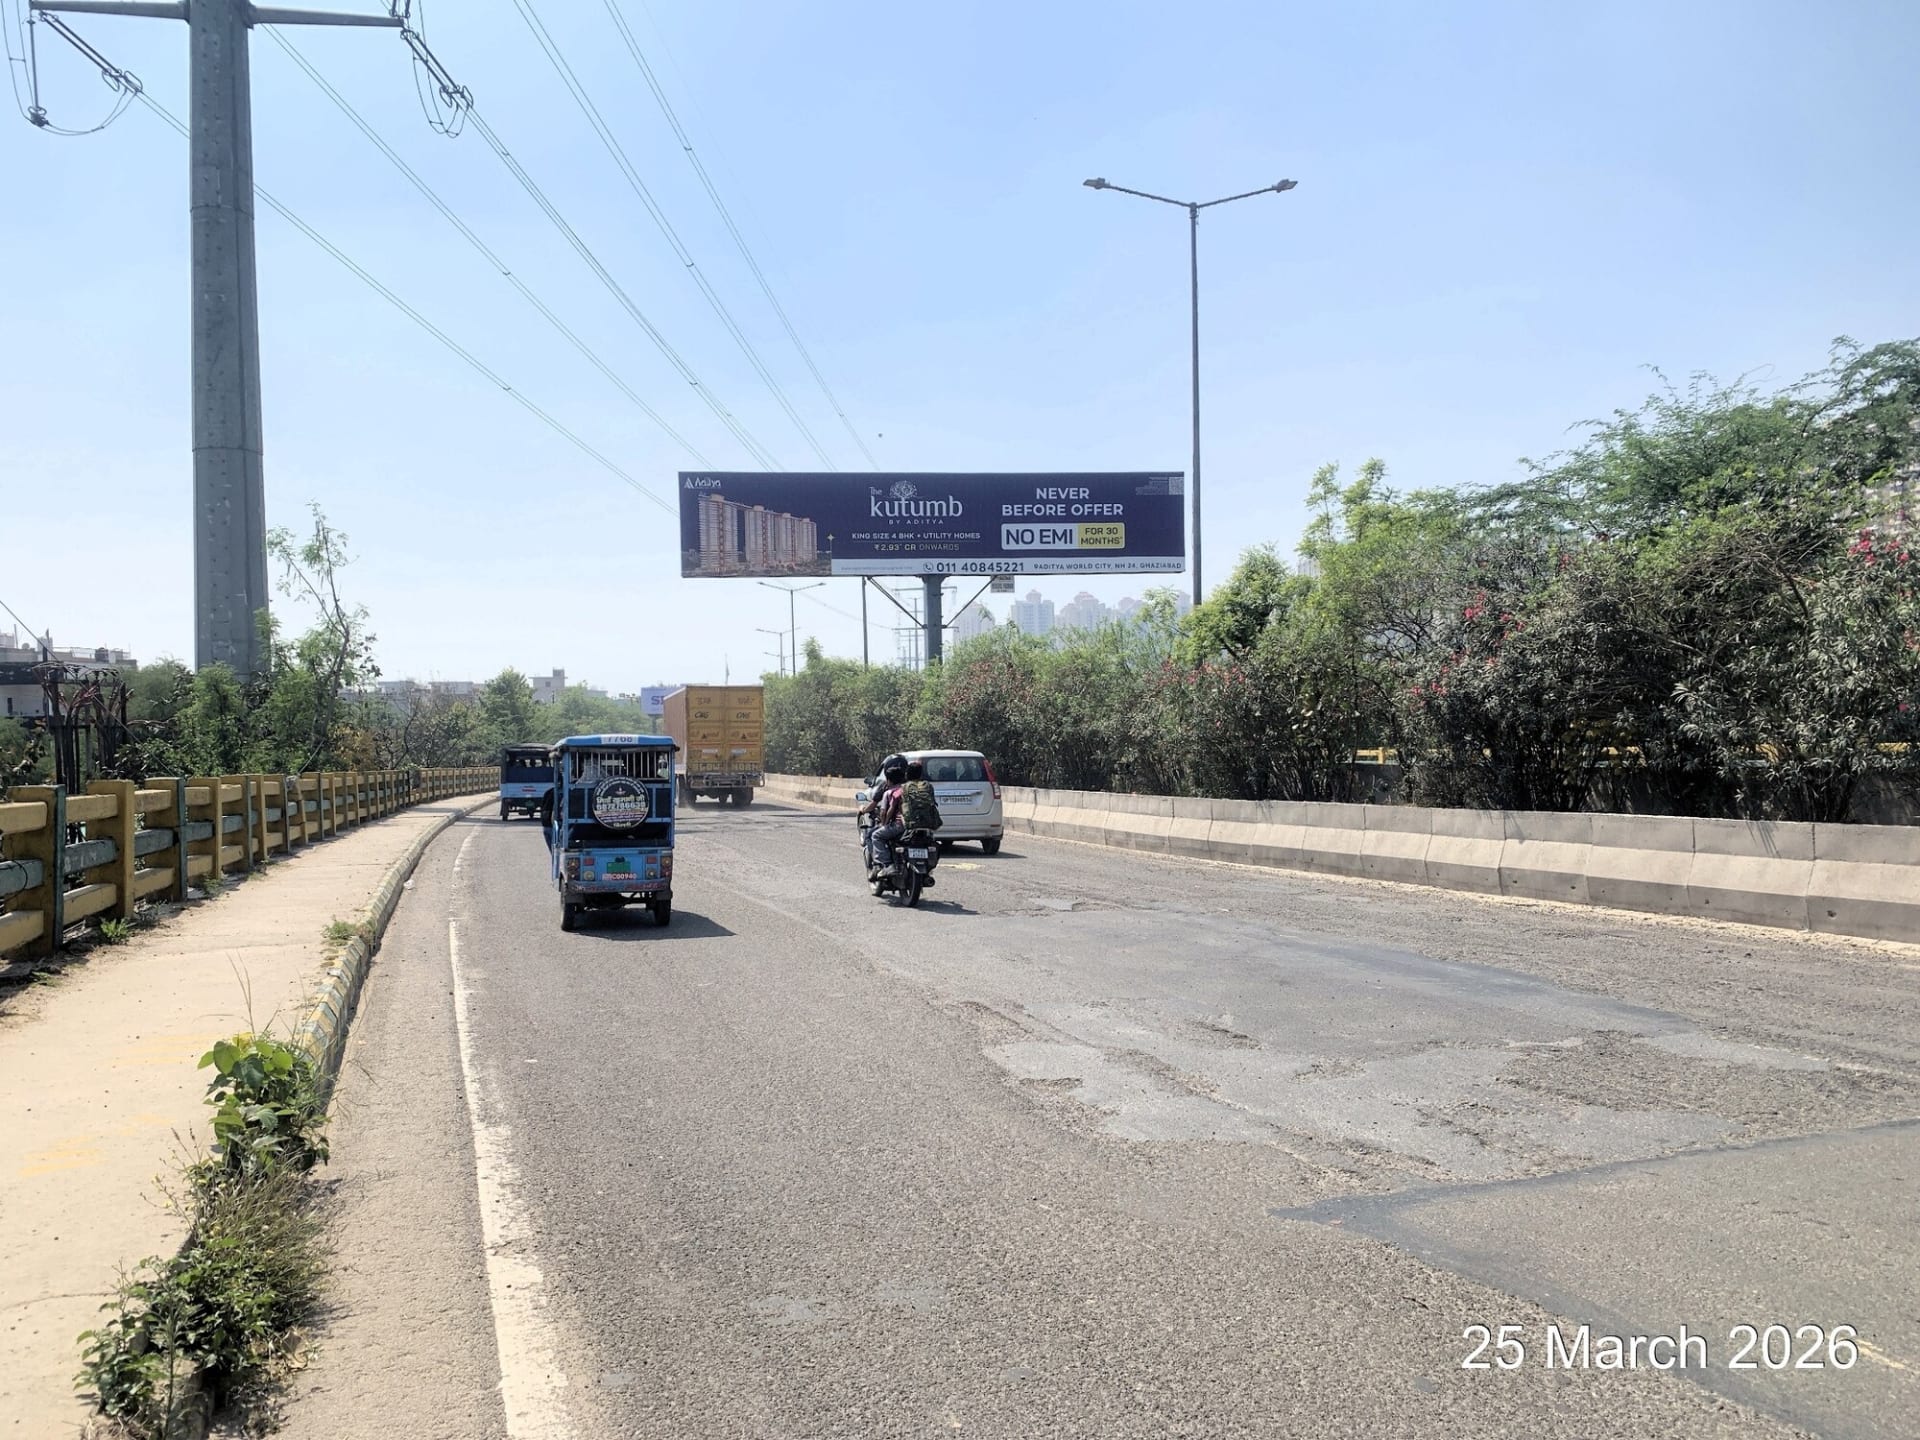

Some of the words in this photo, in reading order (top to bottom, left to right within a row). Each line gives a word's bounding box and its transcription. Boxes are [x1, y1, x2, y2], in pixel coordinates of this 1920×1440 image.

[869, 486, 882, 496] The
[1036, 487, 1090, 500] NEVER
[870, 495, 963, 517] kutumb
[1002, 504, 1066, 516] BEFORE
[1071, 503, 1124, 516] OFFER
[1006, 528, 1034, 545] NO
[1039, 528, 1073, 545] EMI
[1085, 527, 1103, 535] FOR
[1106, 527, 1118, 535] 30
[904, 543, 917, 551] CR
[920, 543, 960, 551] ONWARDS
[936, 562, 956, 573] 011
[961, 561, 1024, 572] 40845221
